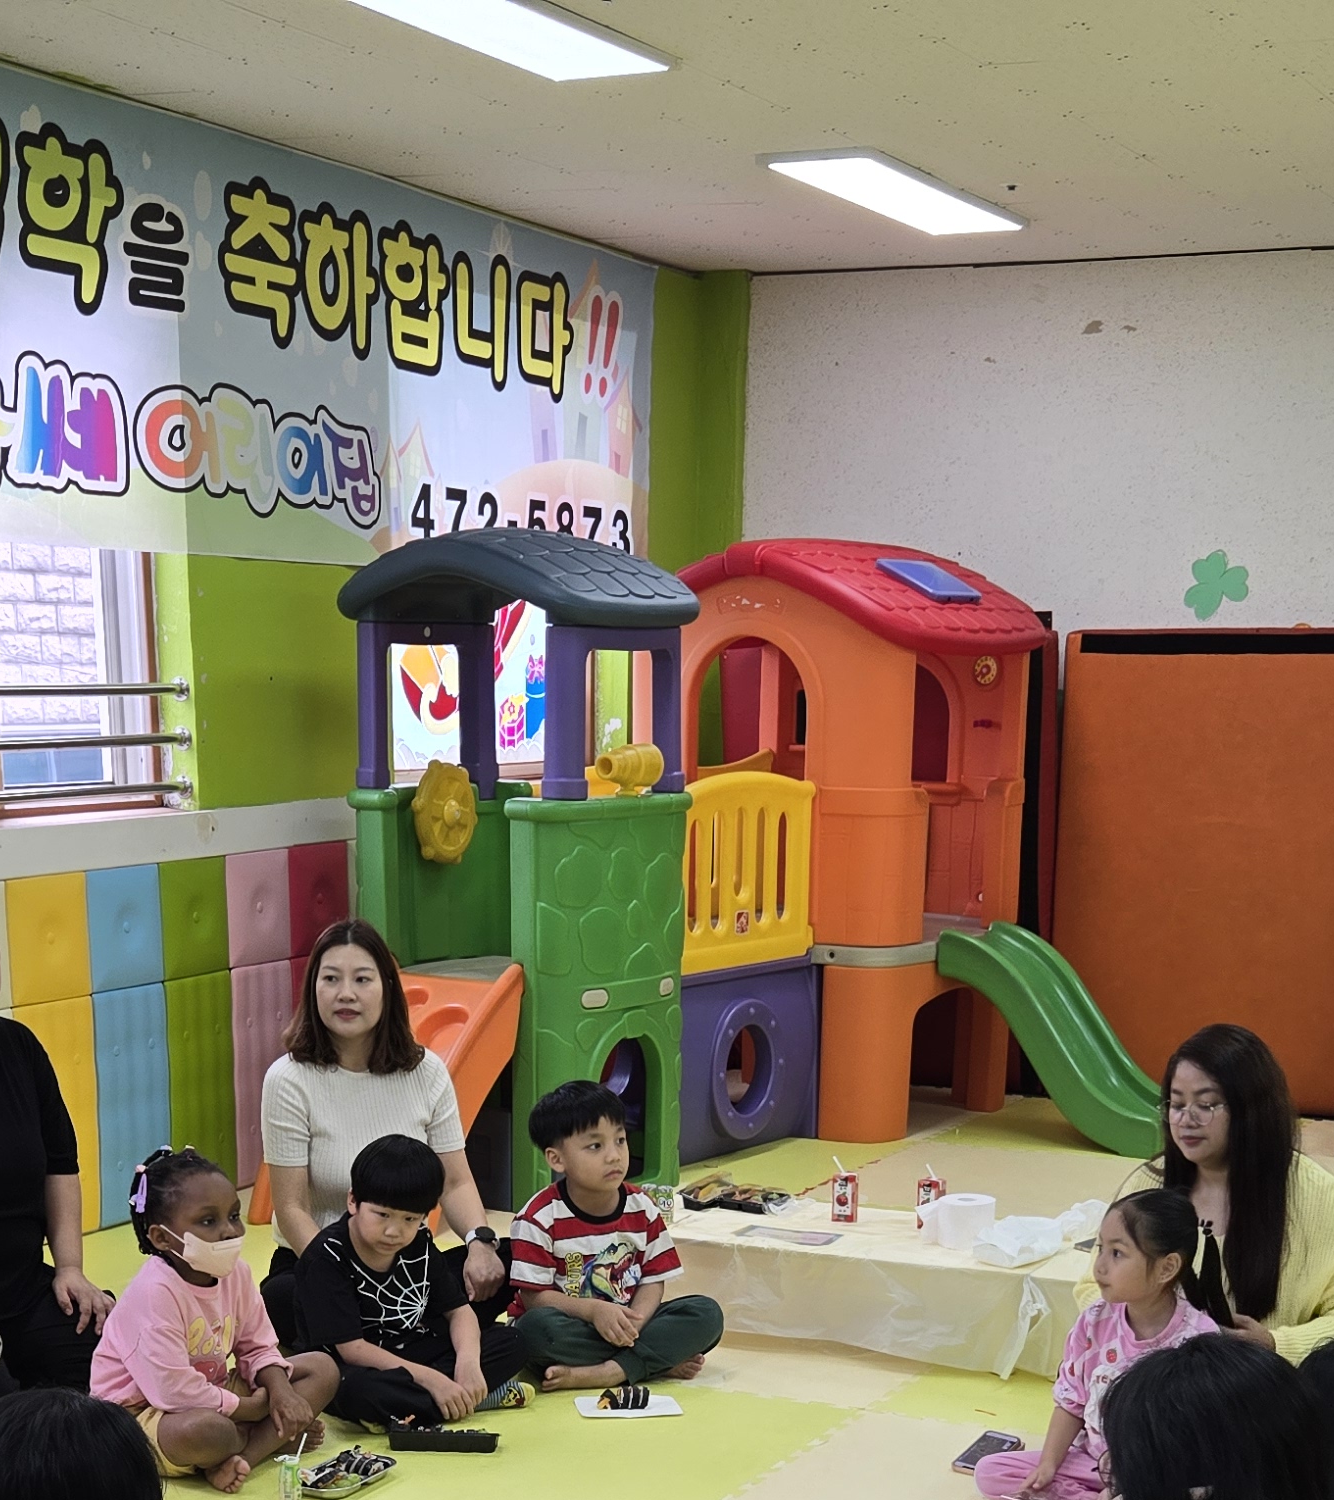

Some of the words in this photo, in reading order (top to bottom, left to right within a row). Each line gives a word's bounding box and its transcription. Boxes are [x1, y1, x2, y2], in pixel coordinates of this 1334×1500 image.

[218, 177, 623, 403] 축하합니다!!
[134, 383, 381, 528] 어린이집
[411, 483, 632, 556] 472-5873
